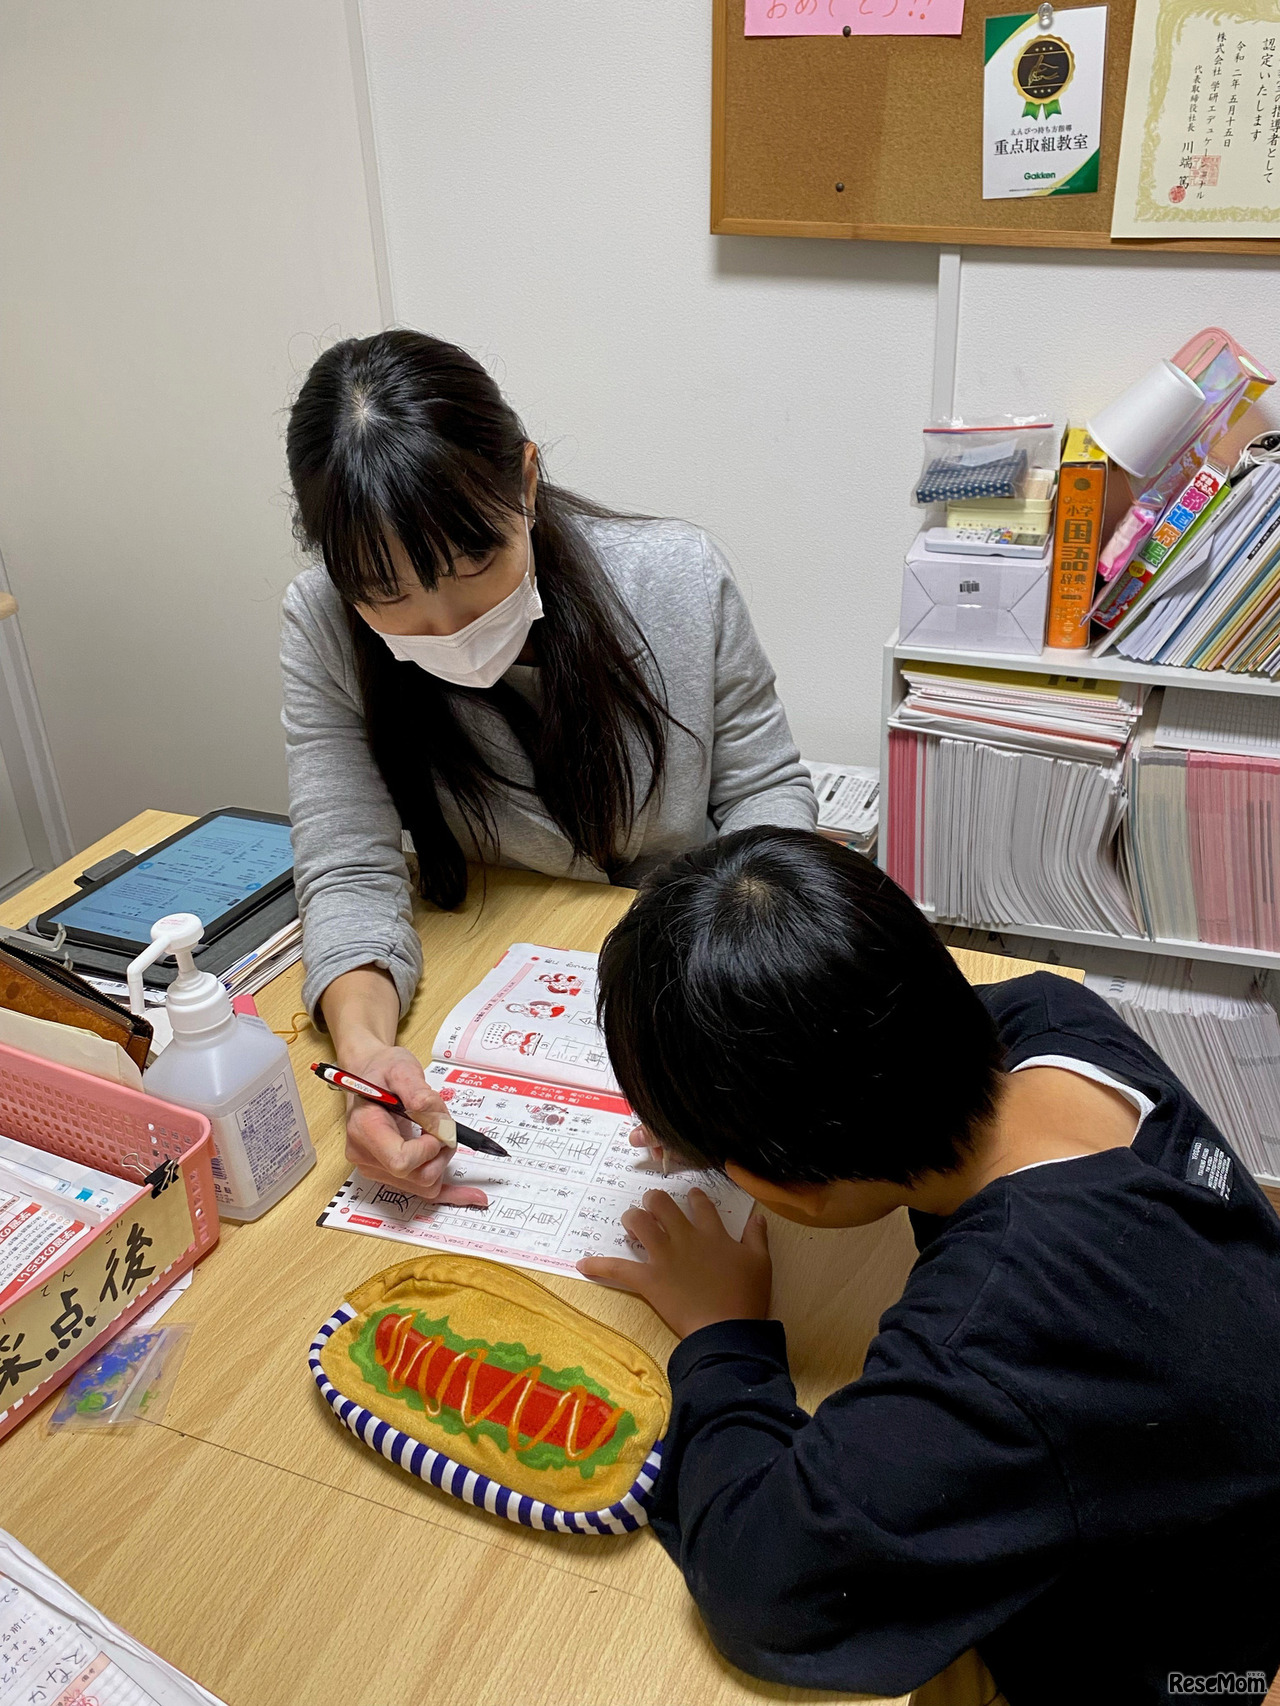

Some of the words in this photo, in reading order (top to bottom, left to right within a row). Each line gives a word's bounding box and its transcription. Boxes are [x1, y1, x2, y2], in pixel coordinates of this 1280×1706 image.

[1250, 38, 1276, 142] 認定いたします
[994, 134, 1088, 156] 重点取組教室
[1024, 172, 1056, 180] Gakken
[1066, 505, 1095, 517] 小学
[1139, 486, 1210, 568] 都道府県
[1061, 519, 1093, 572] 国語
[1060, 574, 1087, 585] 辞典
[456, 1077, 483, 1087] ならう
[490, 1083, 518, 1094] かん字
[16, 1229, 76, 1283] 学習のねらい
